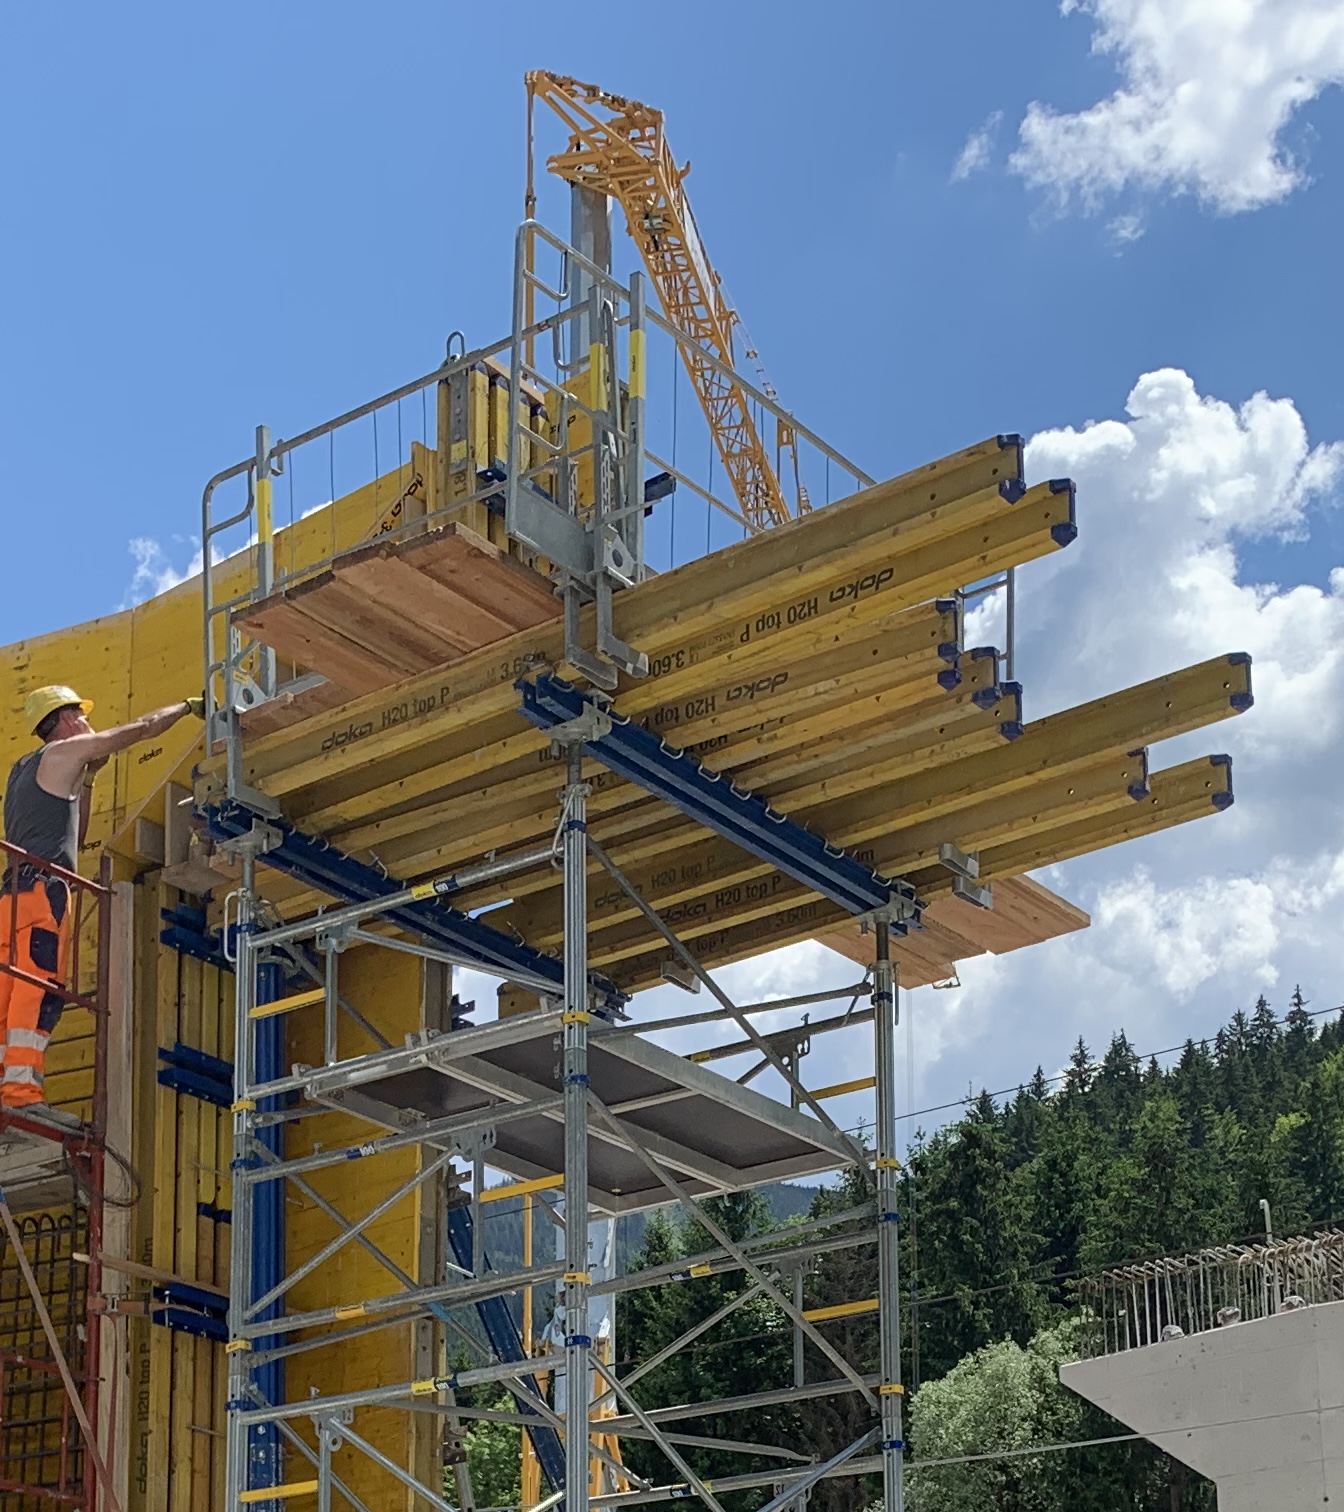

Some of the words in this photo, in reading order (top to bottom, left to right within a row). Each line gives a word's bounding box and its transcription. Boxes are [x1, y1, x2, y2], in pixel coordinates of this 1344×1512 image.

[829, 567, 894, 604] doka
[756, 611, 782, 633] top
[787, 597, 818, 625] H20
[740, 623, 751, 644] P
[648, 649, 685, 679] 3.60
[726, 671, 789, 701] doka
[321, 720, 373, 750] doka
[381, 702, 407, 728] H20
[413, 695, 436, 715] top
[440, 686, 450, 704] P
[655, 707, 681, 727] top
[685, 695, 716, 720] H20
[138, 747, 164, 765] doka
[651, 870, 677, 891] H20
[682, 861, 703, 881] top
[707, 855, 716, 873] P
[715, 888, 741, 909] H20
[746, 880, 768, 901] top
[773, 874, 782, 893] P
[141, 1342, 151, 1354] P
[140, 1356, 151, 1386] top
[138, 1388, 150, 1423] H20
[136, 1432, 149, 1495] doka
